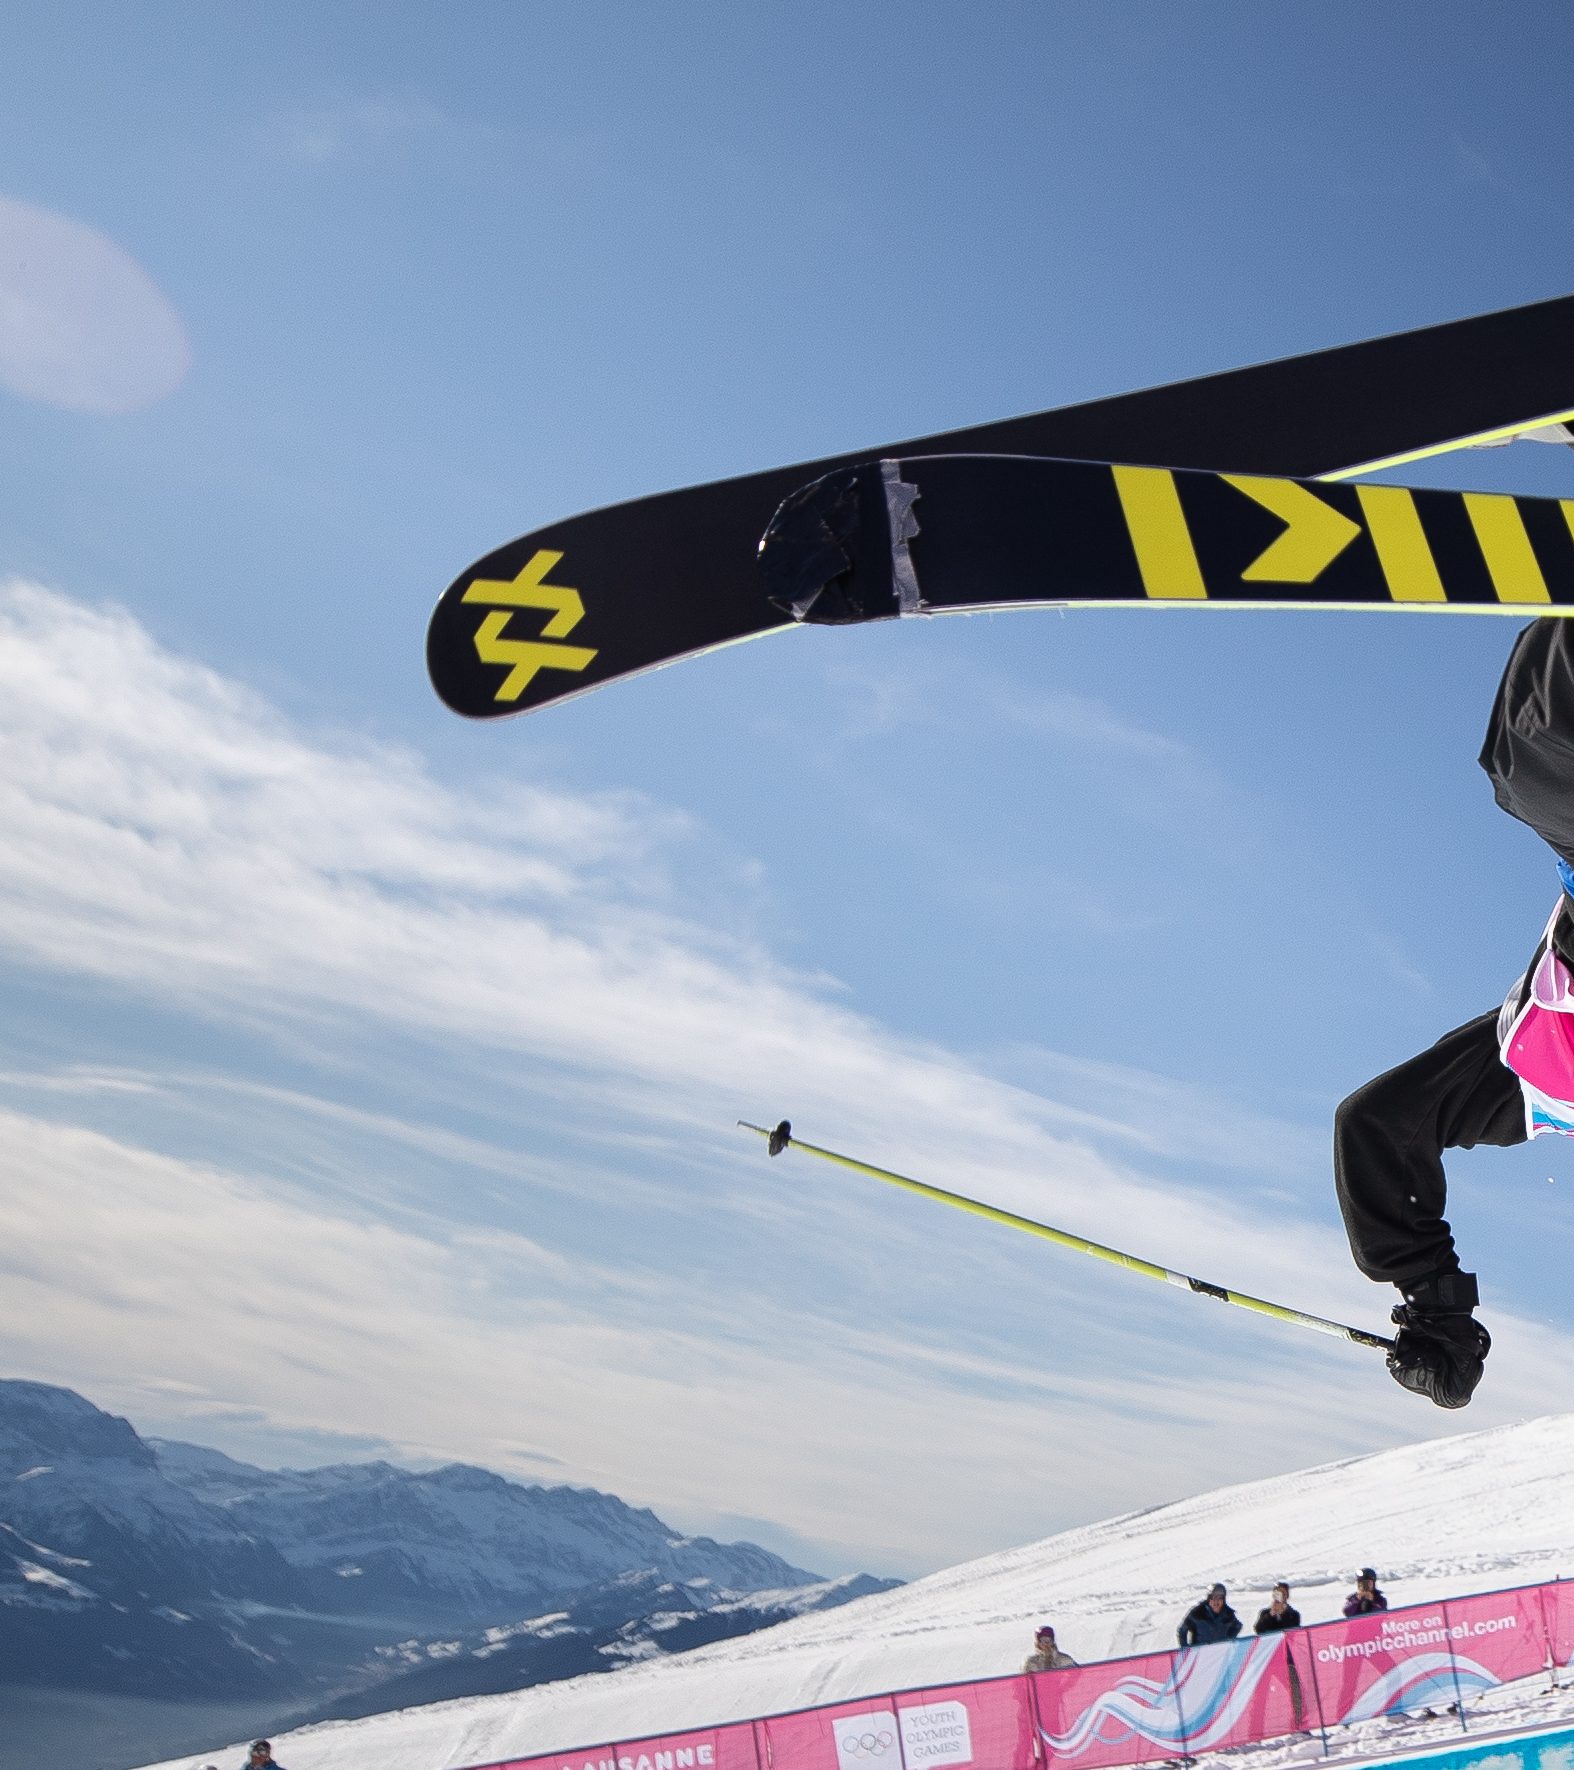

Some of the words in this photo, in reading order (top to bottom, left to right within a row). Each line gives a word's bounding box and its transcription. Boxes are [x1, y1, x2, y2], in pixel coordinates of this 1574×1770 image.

[1381, 1620, 1420, 1635] More
[1422, 1615, 1442, 1628] on
[1317, 1615, 1517, 1663] olympicchannel.com
[910, 1710, 956, 1728] YOUTH
[906, 1725, 965, 1744] OLYMPIC
[913, 1740, 960, 1758] GAMES
